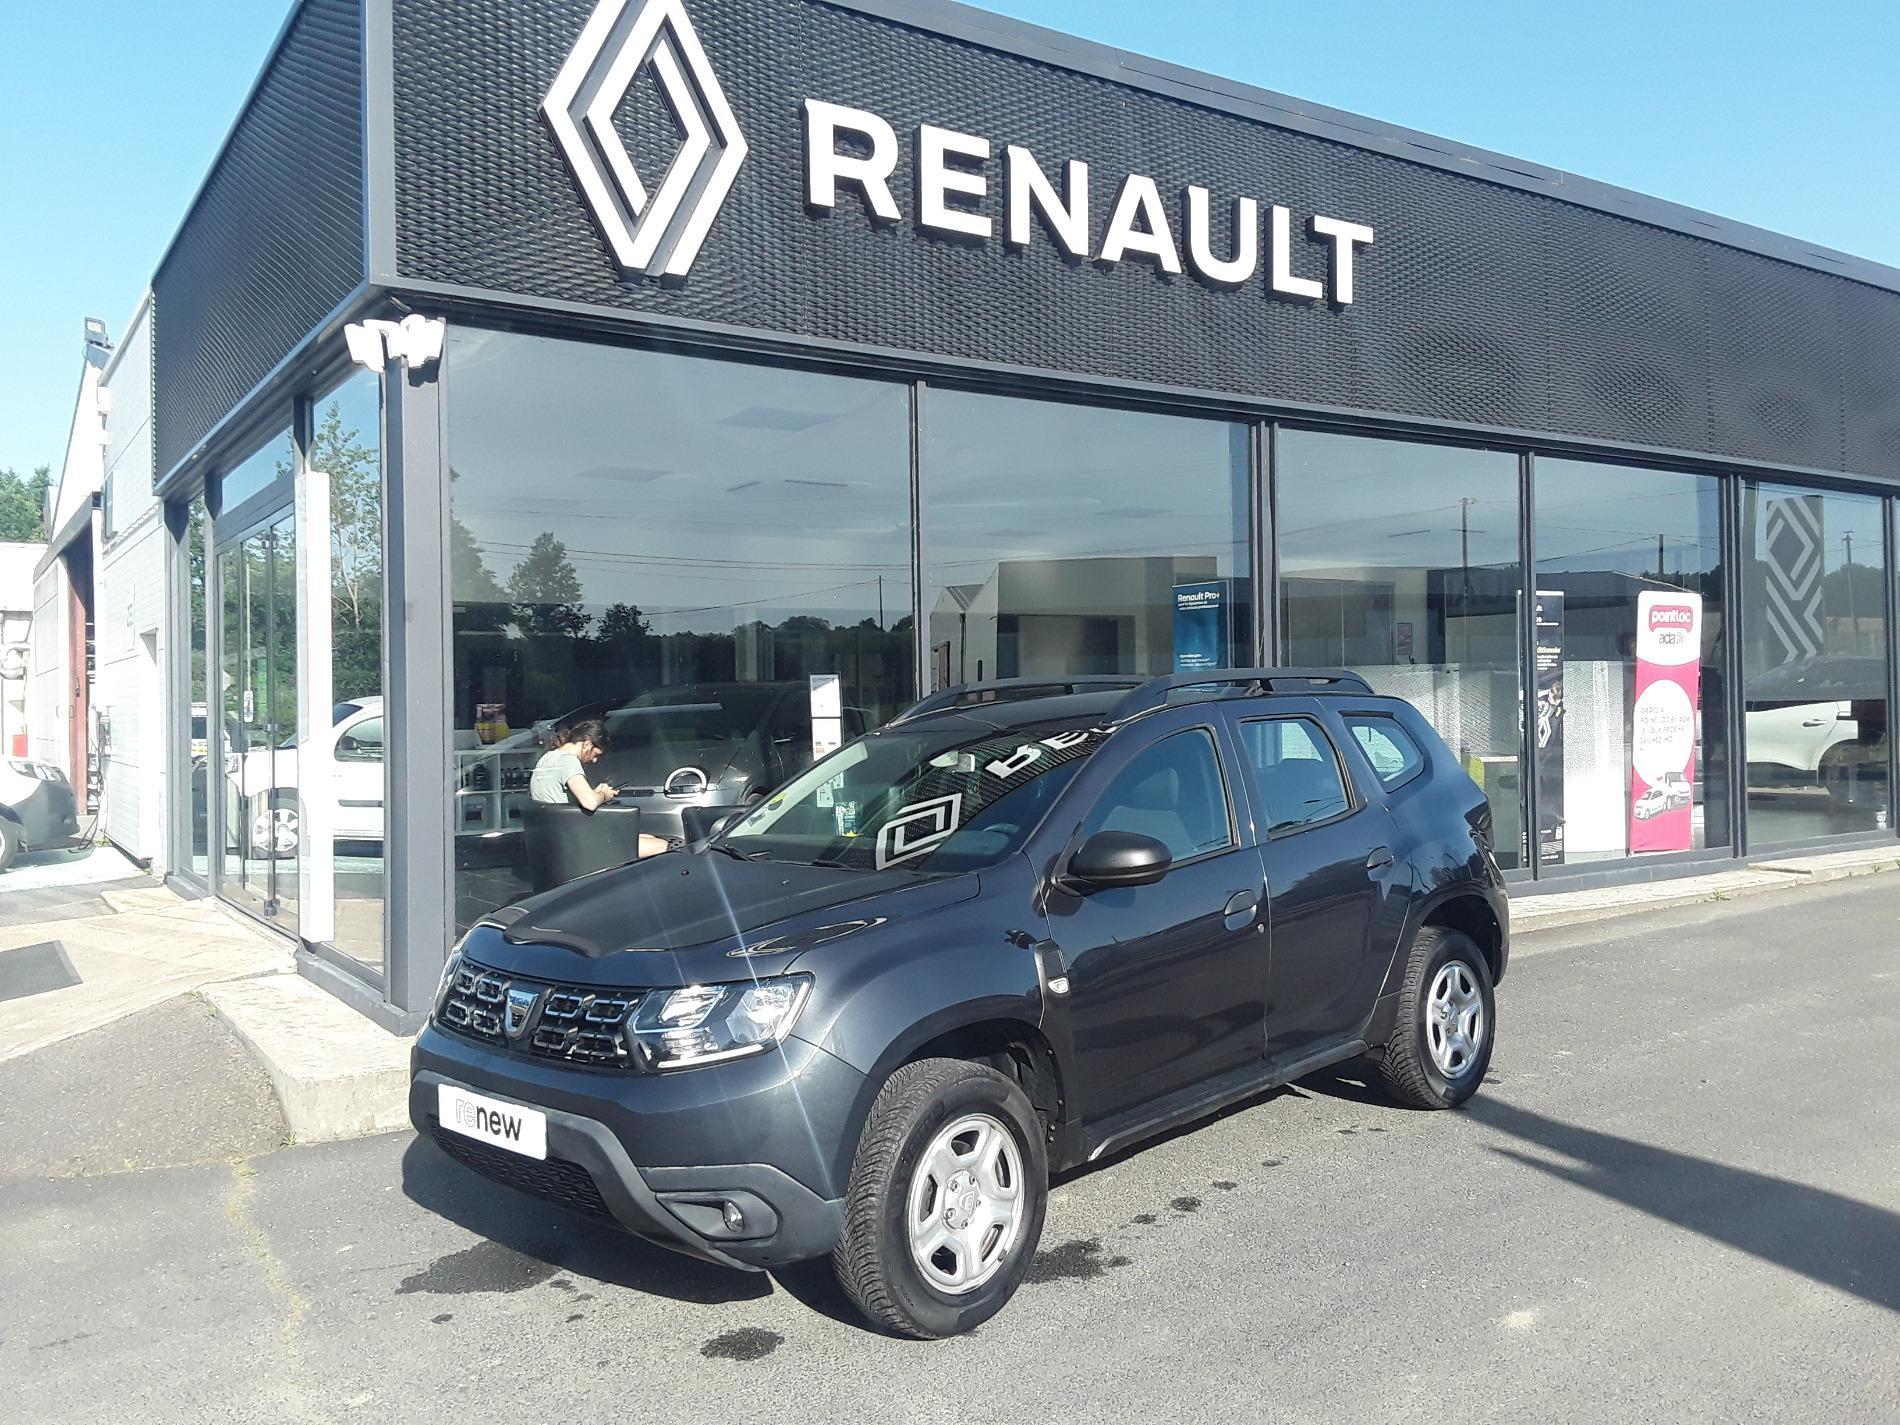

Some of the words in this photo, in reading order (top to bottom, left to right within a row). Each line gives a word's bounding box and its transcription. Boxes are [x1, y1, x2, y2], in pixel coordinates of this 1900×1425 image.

[804, 99, 1374, 304] RENAULT
[1178, 592, 1204, 602] Renault
[1204, 592, 1220, 600] Pro+
[1659, 632, 1676, 645] ada
[456, 1098, 522, 1141] renew
